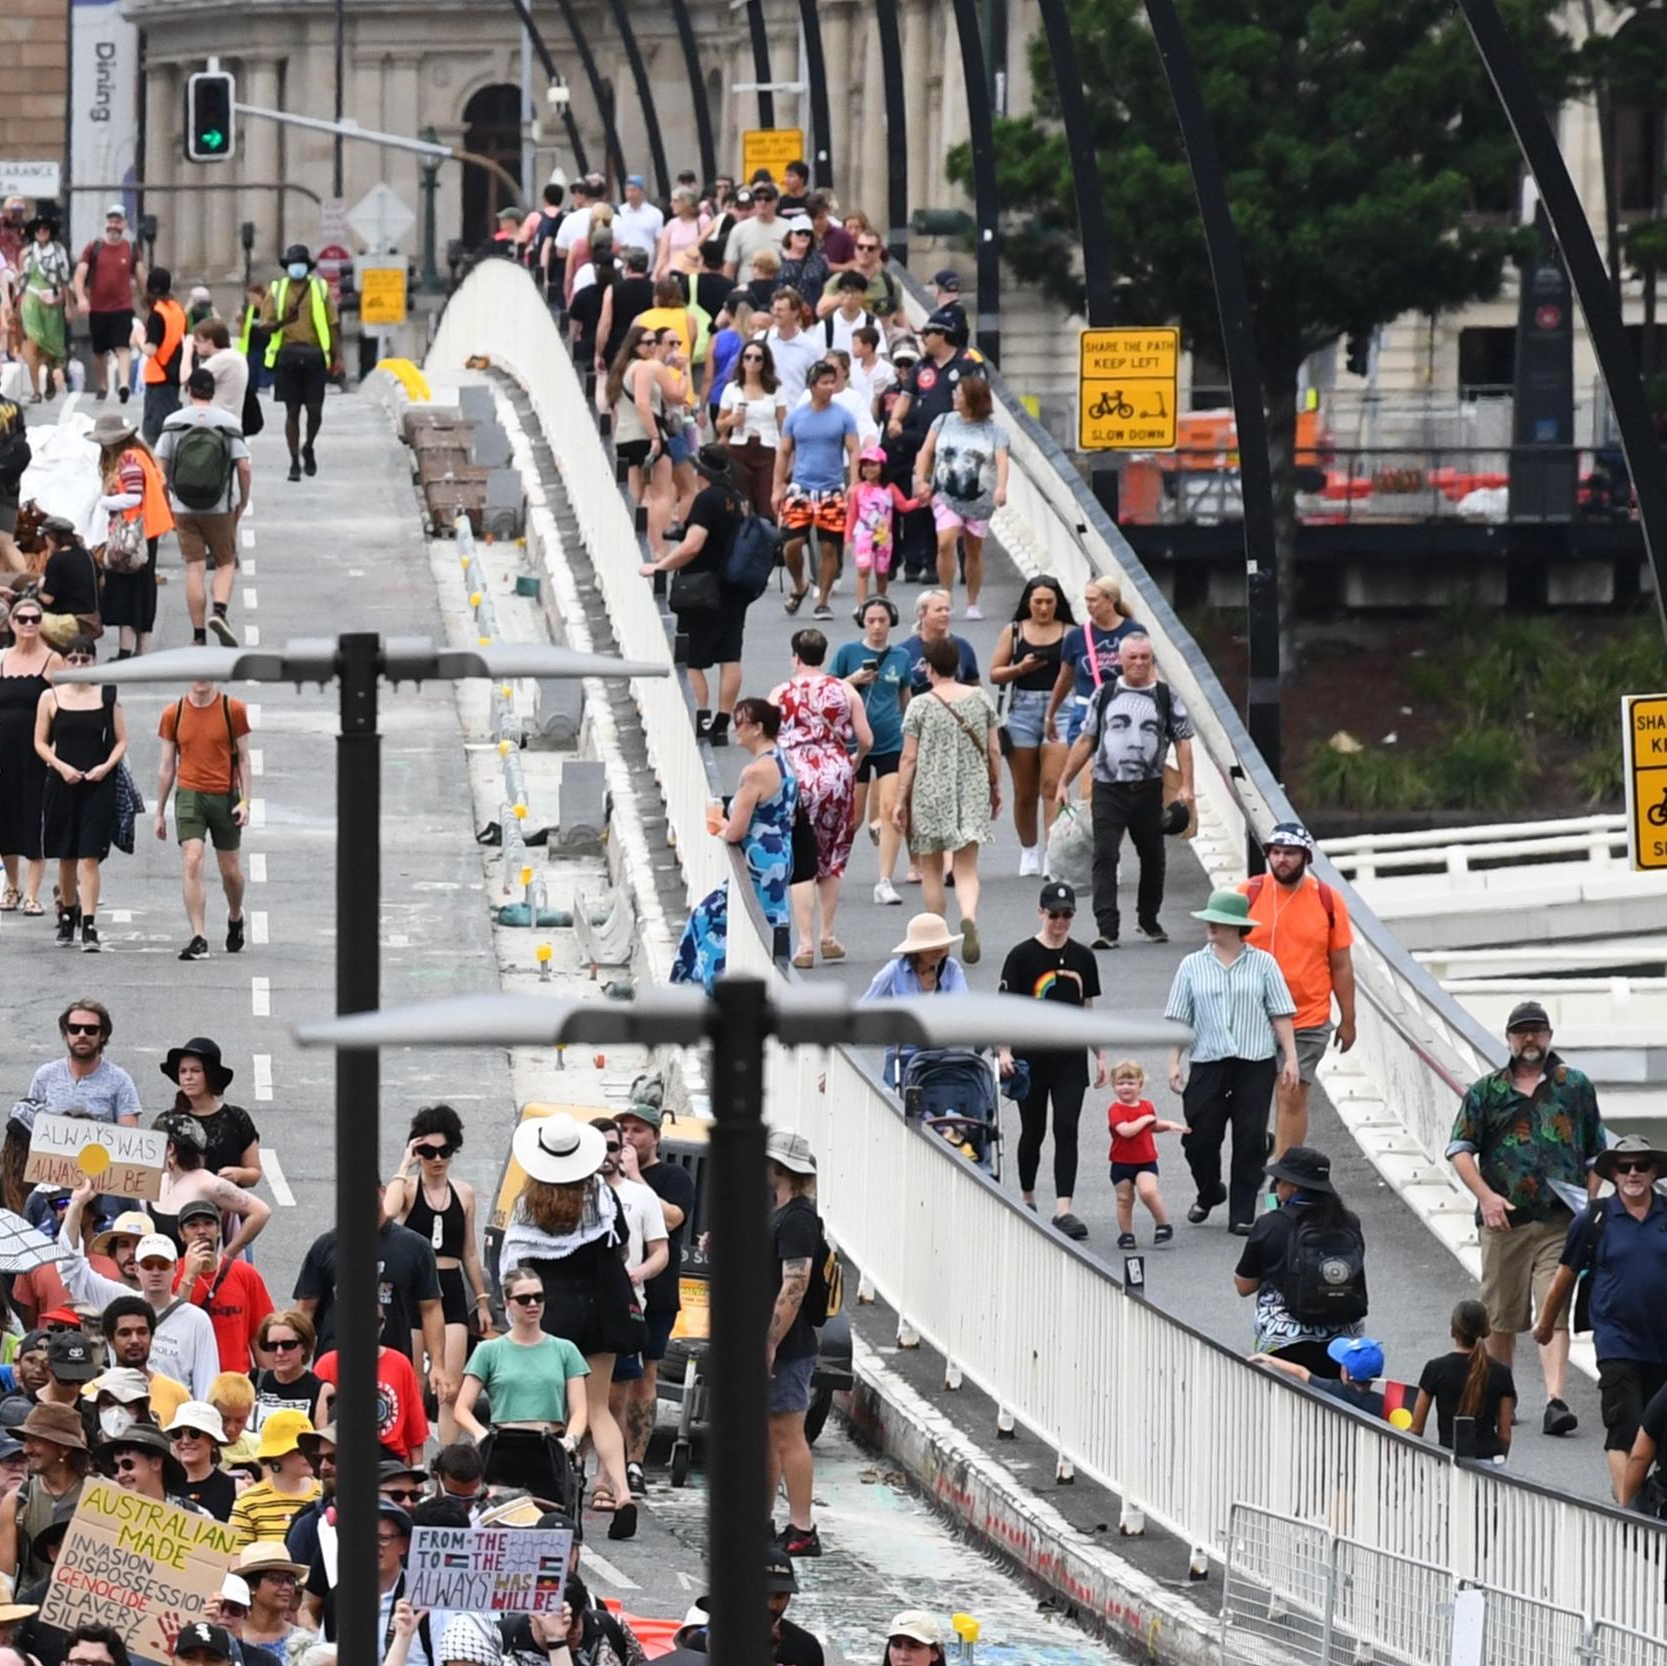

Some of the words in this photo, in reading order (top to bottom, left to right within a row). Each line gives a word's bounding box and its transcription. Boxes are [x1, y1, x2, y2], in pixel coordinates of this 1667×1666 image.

[90, 42, 115, 122] Dining
[1086, 342, 1118, 353] SHARE
[1123, 341, 1142, 352] THE
[1146, 341, 1174, 352] PATH
[1094, 358, 1127, 369] KEEP
[1131, 357, 1158, 368] LEFT
[1092, 430, 1124, 442] SLOW
[1129, 429, 1165, 441] DOWN
[37, 1124, 114, 1148] ALWAYS
[118, 1136, 155, 1160] WAS
[123, 1171, 147, 1193] BE
[81, 1487, 238, 1556] AUSTRALIAN
[69, 1532, 153, 1575] INVASION
[117, 1527, 192, 1570] MADE
[474, 1532, 507, 1551] THE
[418, 1551, 439, 1569] TO
[471, 1552, 504, 1571] THE
[49, 1585, 147, 1626] SLAVERY
[56, 1567, 147, 1612] GENOCIDE
[410, 1571, 491, 1609] ALWAYS
[493, 1573, 531, 1592] WAS
